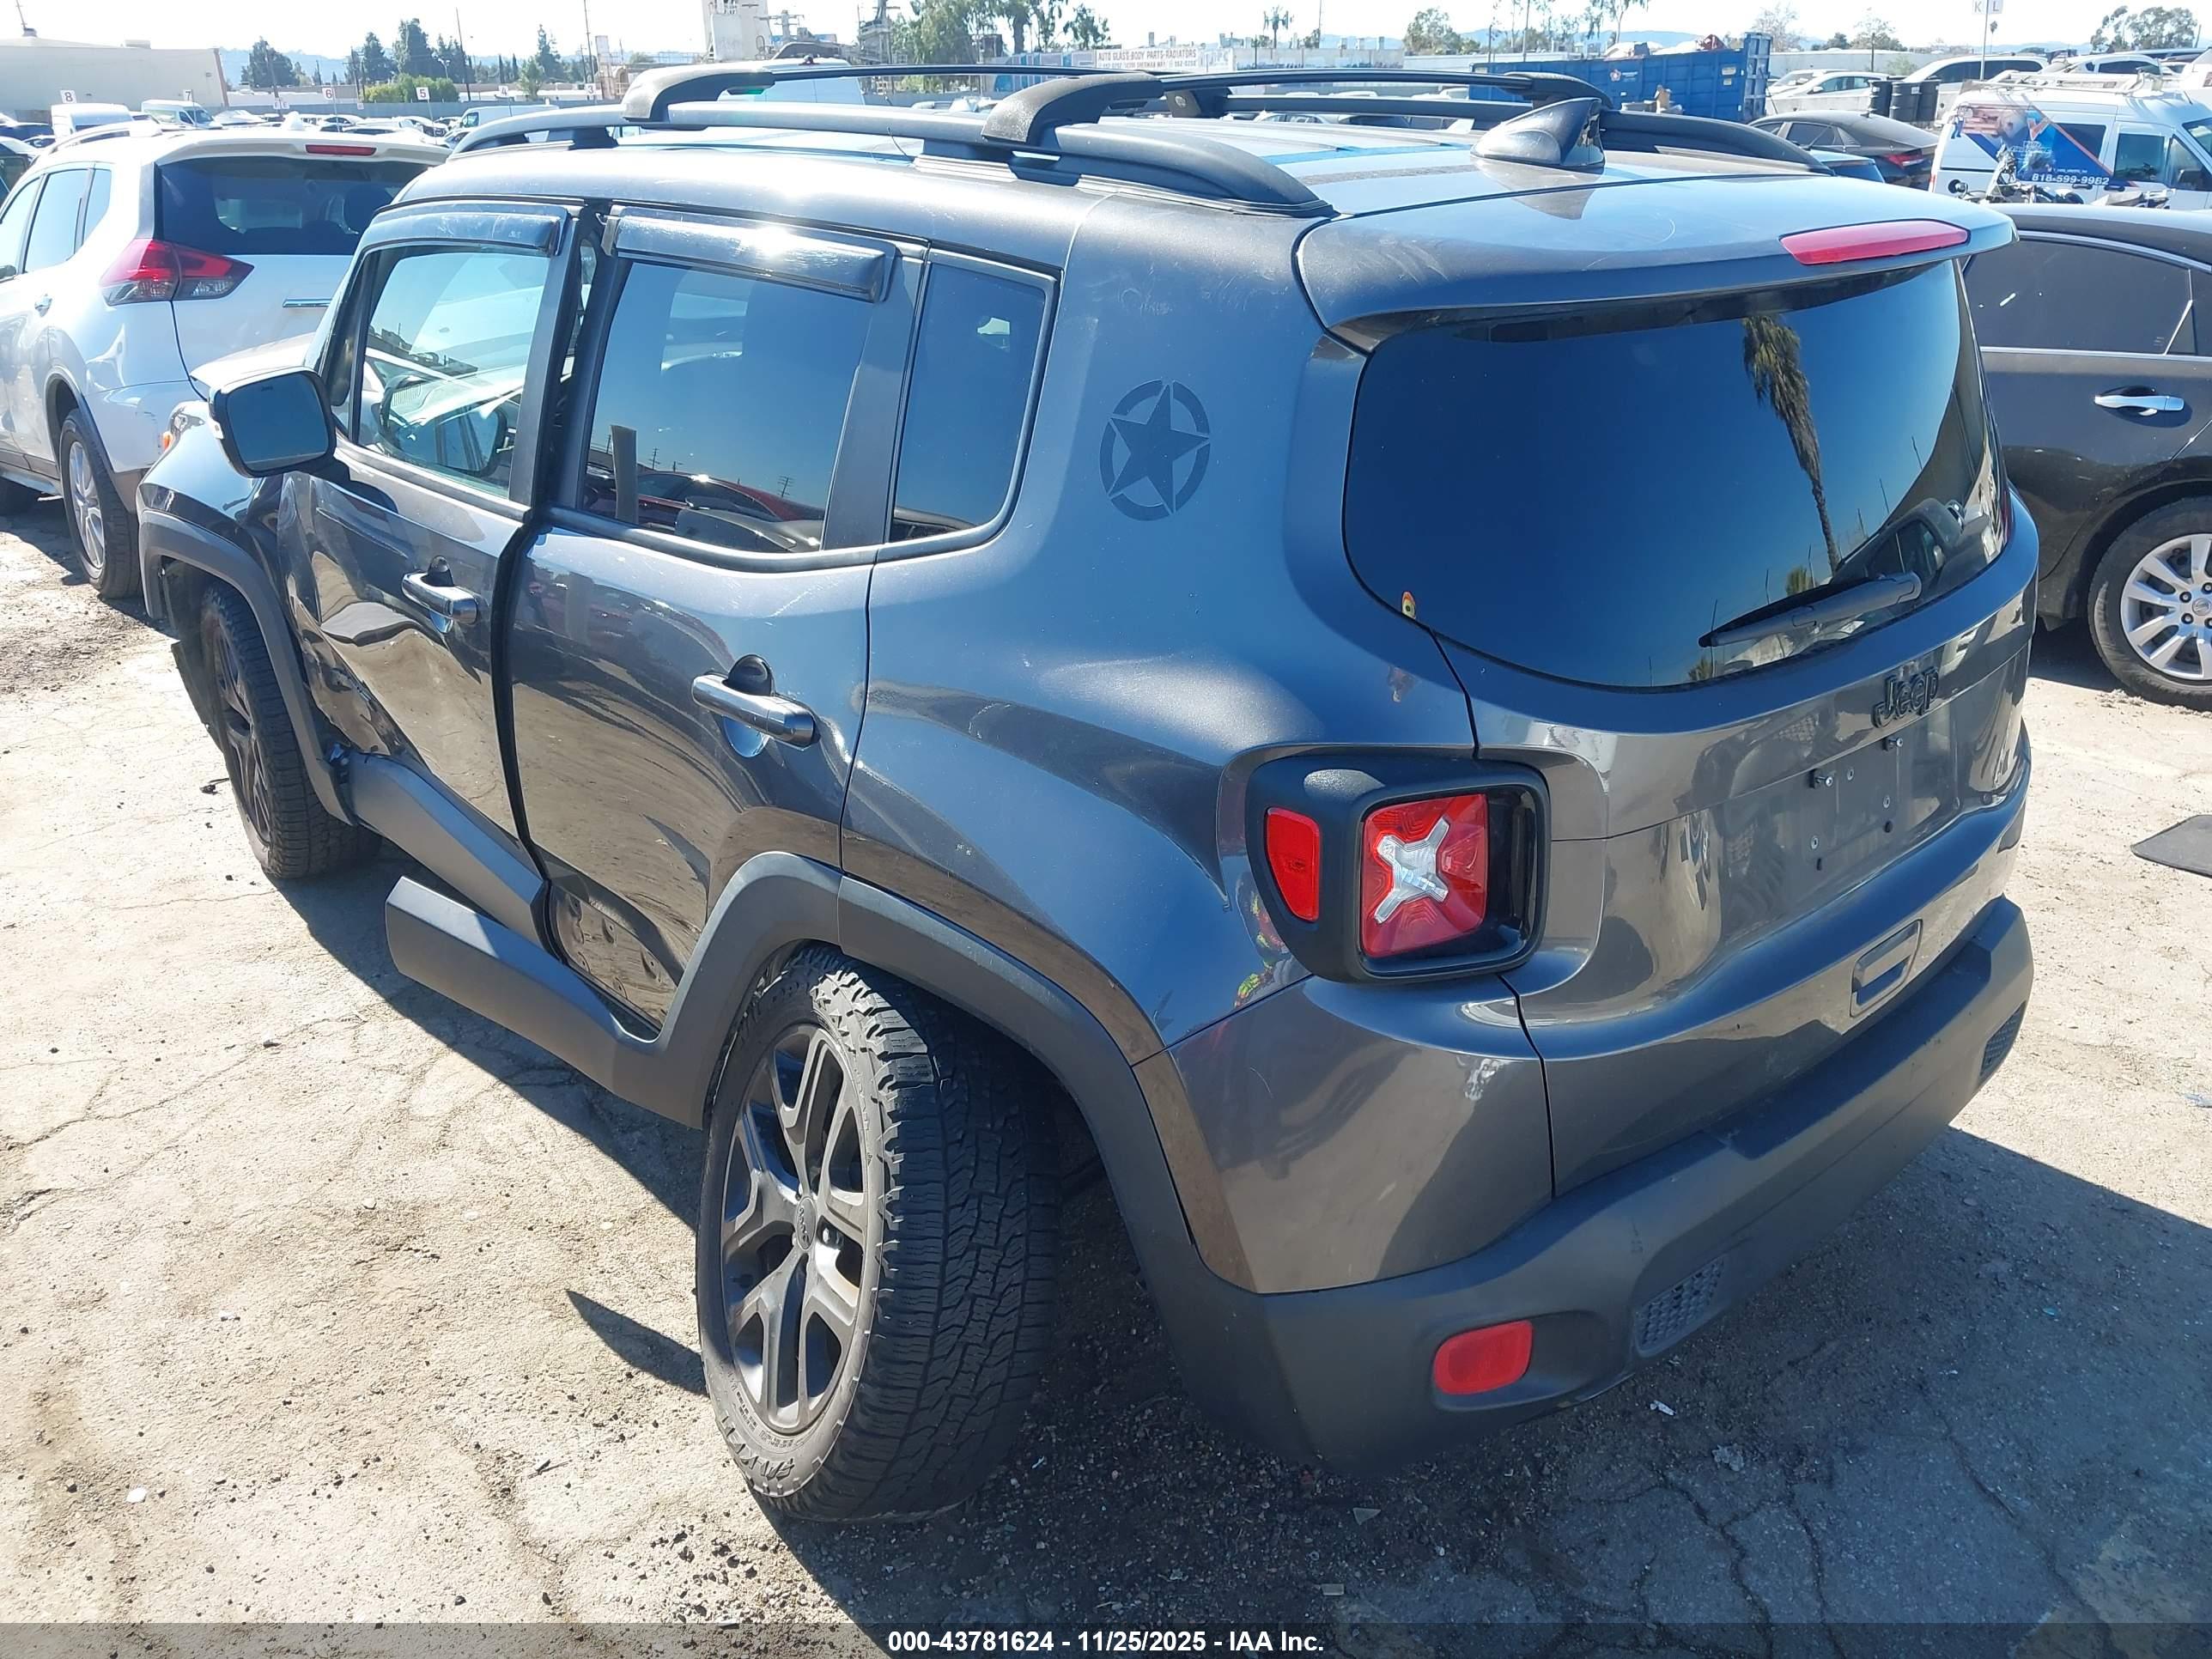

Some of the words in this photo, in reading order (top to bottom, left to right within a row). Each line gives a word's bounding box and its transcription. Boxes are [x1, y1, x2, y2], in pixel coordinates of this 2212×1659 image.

[1974, 0, 1983, 13] K
[1992, 0, 2000, 12] L
[1098, 52, 1111, 61] AUTO
[325, 88, 332, 99] 6
[419, 88, 427, 98] 5
[501, 87, 507, 95] 4
[588, 84, 594, 94] 3
[64, 91, 73, 102] 8
[185, 90, 191, 101] 7
[2032, 173, 2110, 185] 818-599-9982
[1871, 666, 1938, 728] Jeep
